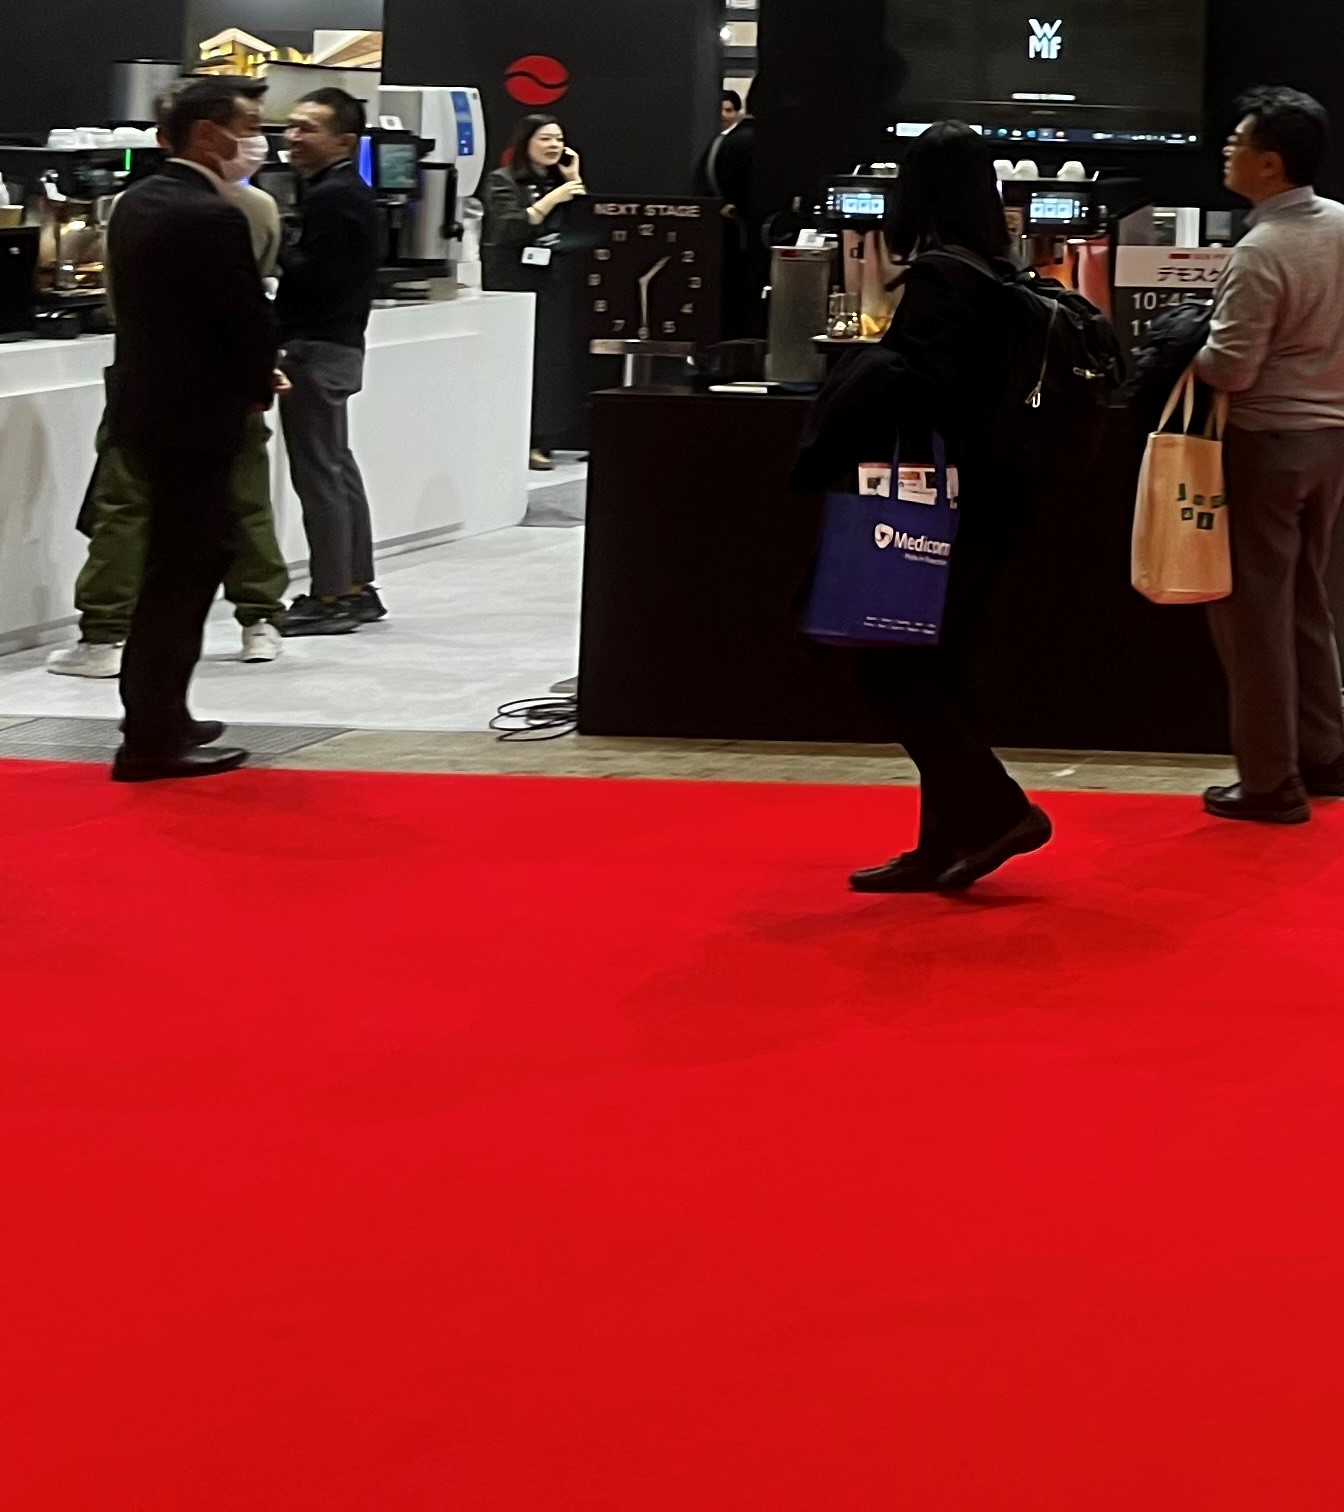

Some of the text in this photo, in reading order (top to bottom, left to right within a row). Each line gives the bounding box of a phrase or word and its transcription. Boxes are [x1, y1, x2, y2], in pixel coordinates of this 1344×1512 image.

[1028, 19, 1062, 59] WMF
[594, 203, 700, 217] NEXT STAGE
